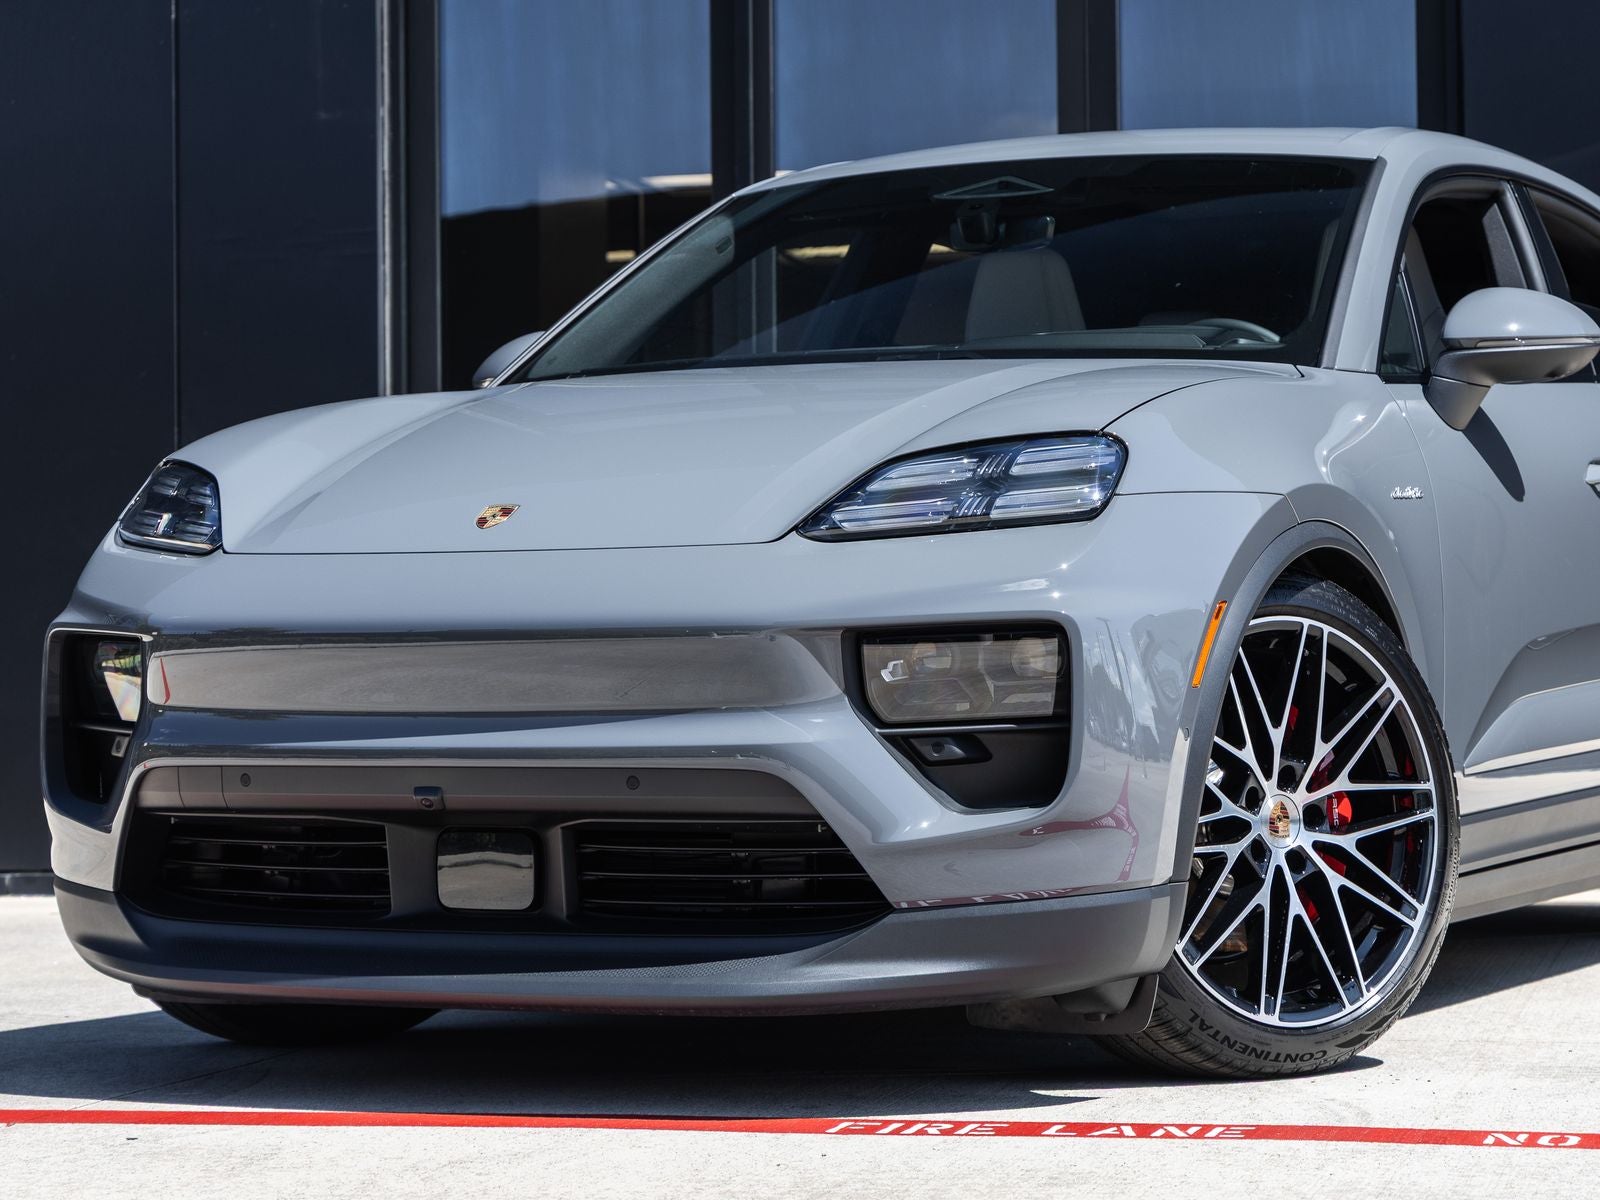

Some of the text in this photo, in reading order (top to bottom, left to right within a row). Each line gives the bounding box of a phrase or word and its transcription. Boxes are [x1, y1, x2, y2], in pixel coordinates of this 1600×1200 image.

[1188, 1008, 1328, 1064] CONTINENTAL
[825, 1121, 1582, 1147] FIRE LANE NO
